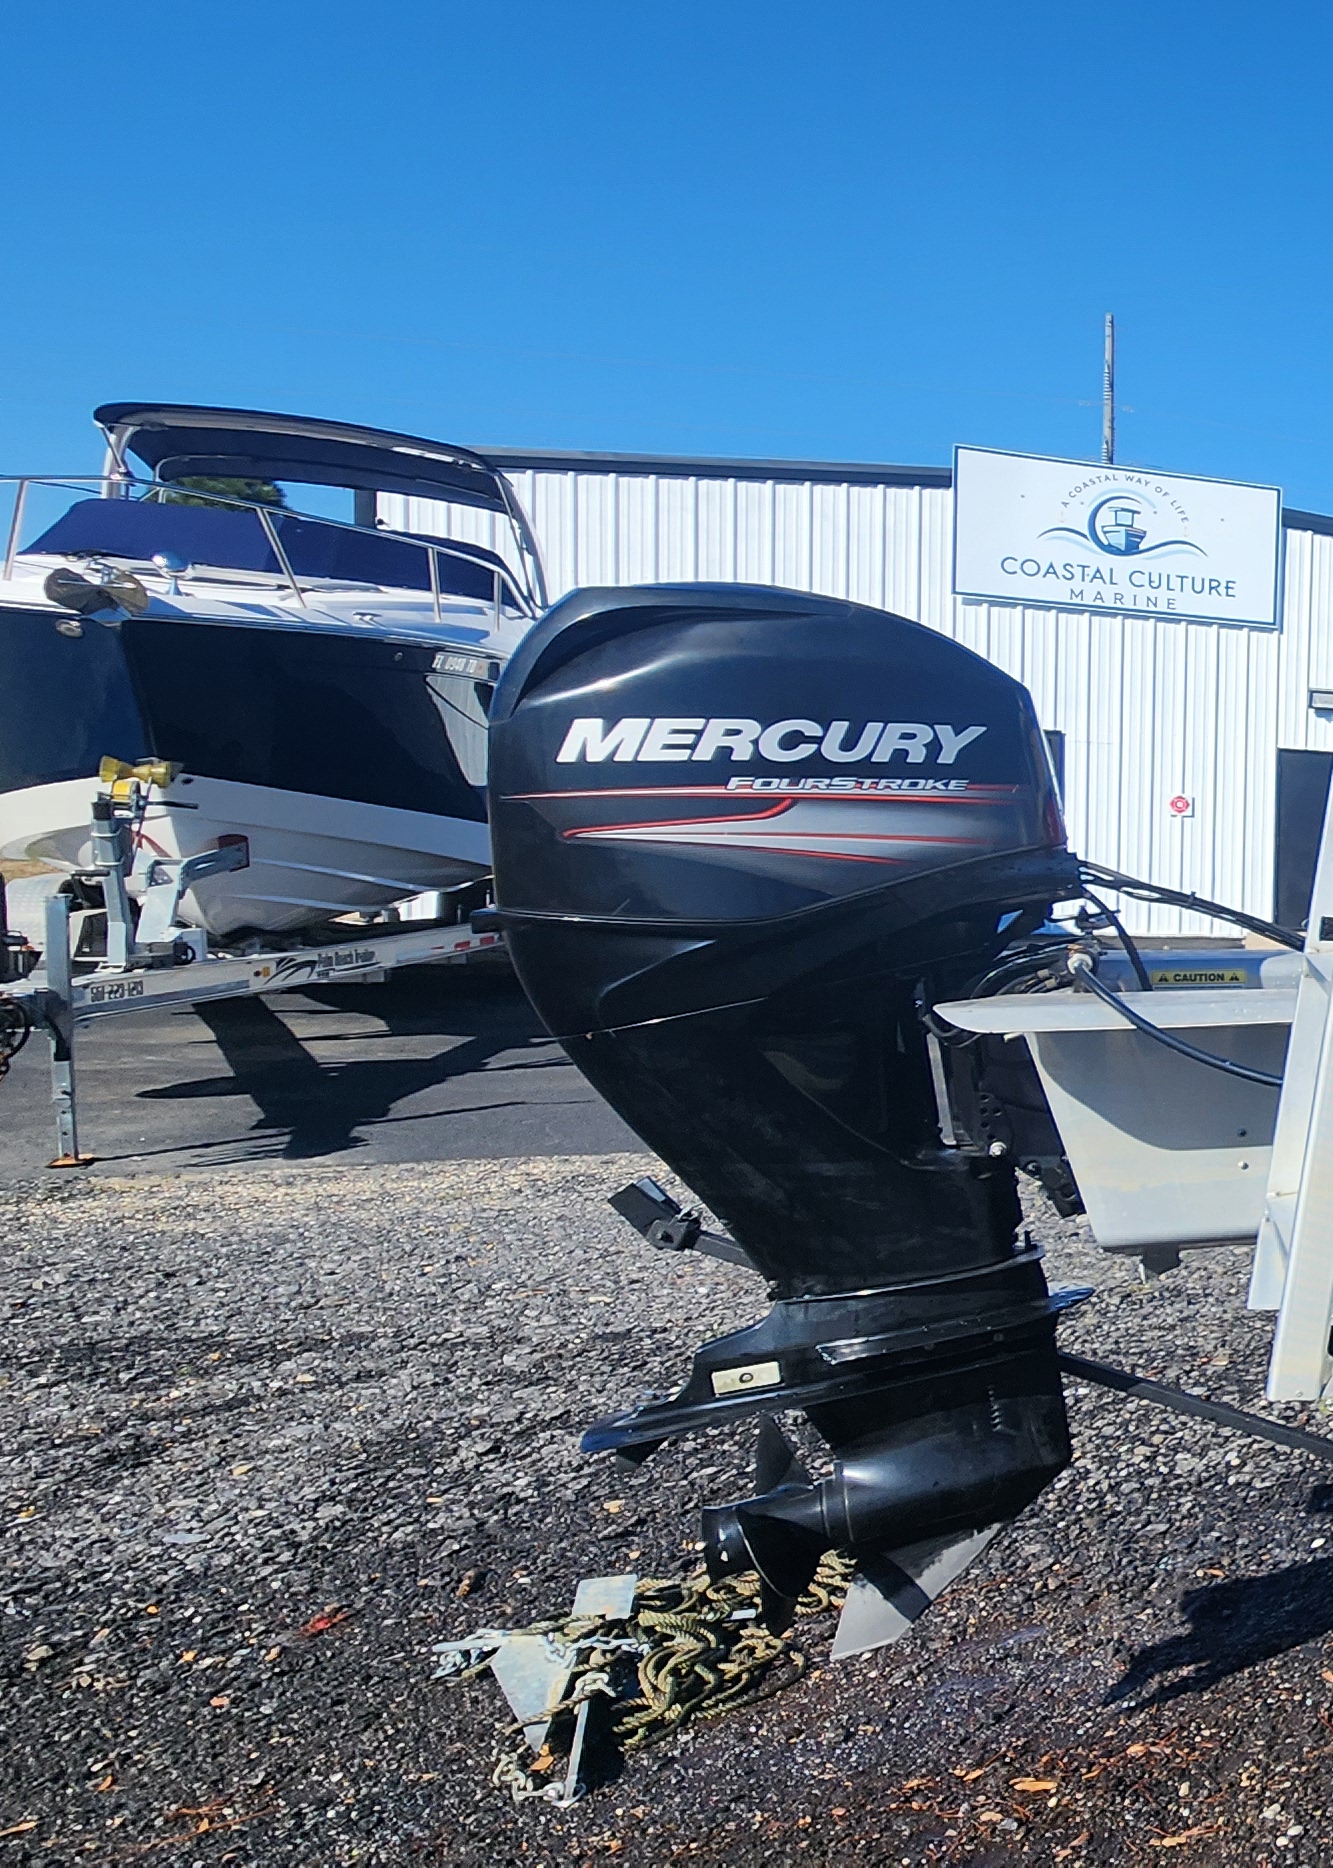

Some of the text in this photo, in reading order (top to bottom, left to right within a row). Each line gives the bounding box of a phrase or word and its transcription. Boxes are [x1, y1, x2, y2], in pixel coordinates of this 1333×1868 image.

[1068, 474, 1118, 498] COASTAL
[1125, 474, 1151, 487] WAY
[1155, 486, 1170, 497] OF
[1170, 500, 1190, 523] LIFE
[1000, 556, 1237, 598] COASTAL CULTURE
[1069, 588, 1177, 610] MARINE
[556, 717, 988, 765] MERCURY
[1173, 973, 1226, 982] CAUTION
